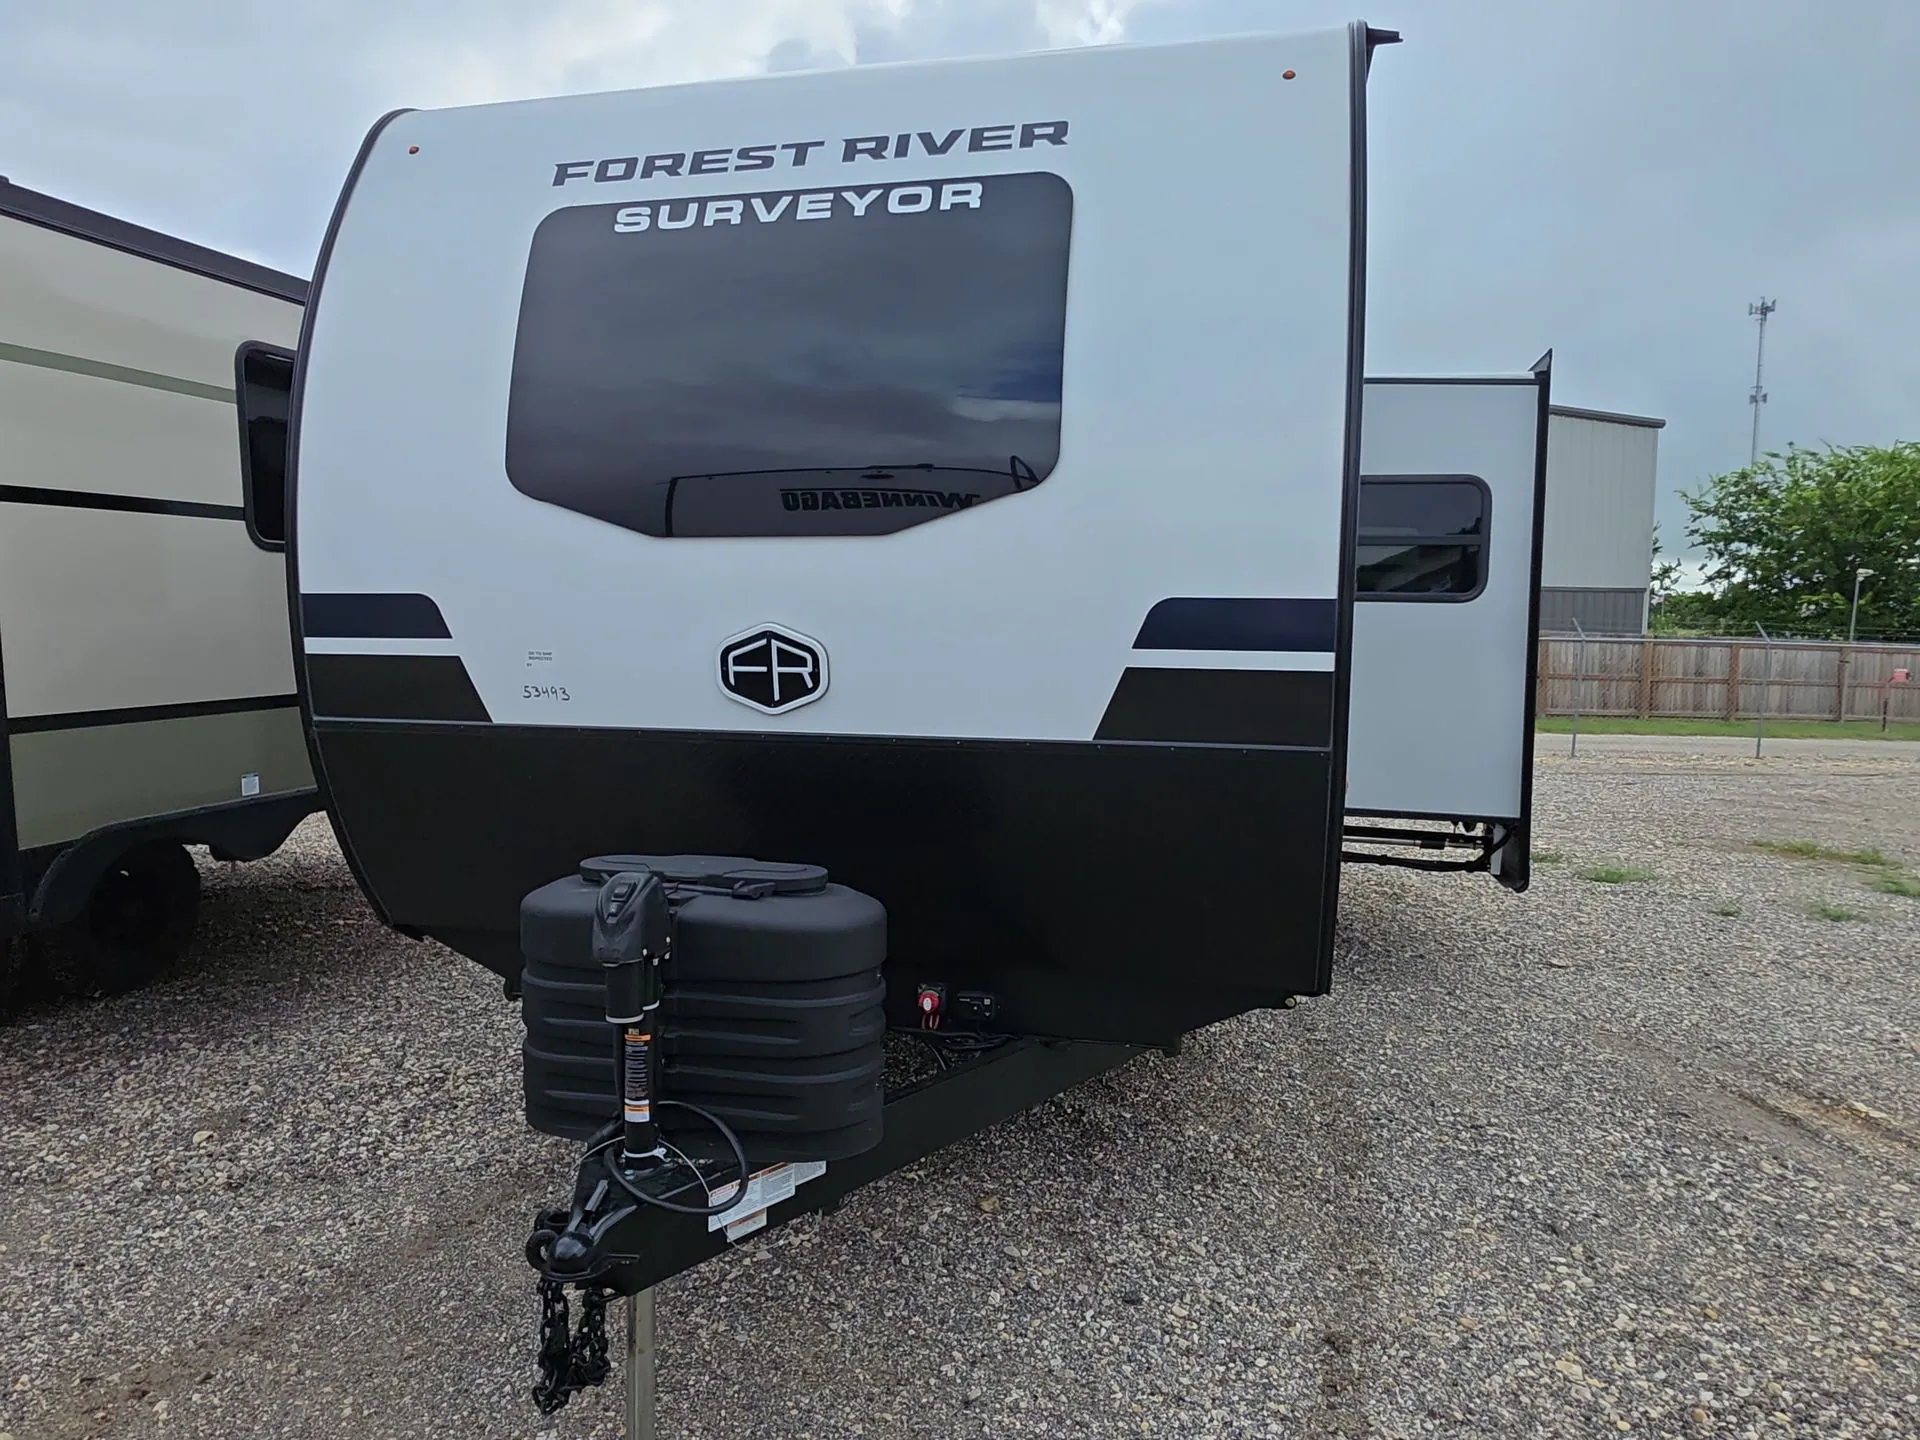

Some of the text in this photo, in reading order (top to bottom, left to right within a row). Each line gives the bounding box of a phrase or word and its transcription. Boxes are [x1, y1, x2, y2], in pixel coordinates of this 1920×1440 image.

[552, 120, 1069, 187] FOREST RIVER
[614, 182, 984, 233] SURVEYOR
[523, 685, 570, 701] 53493
